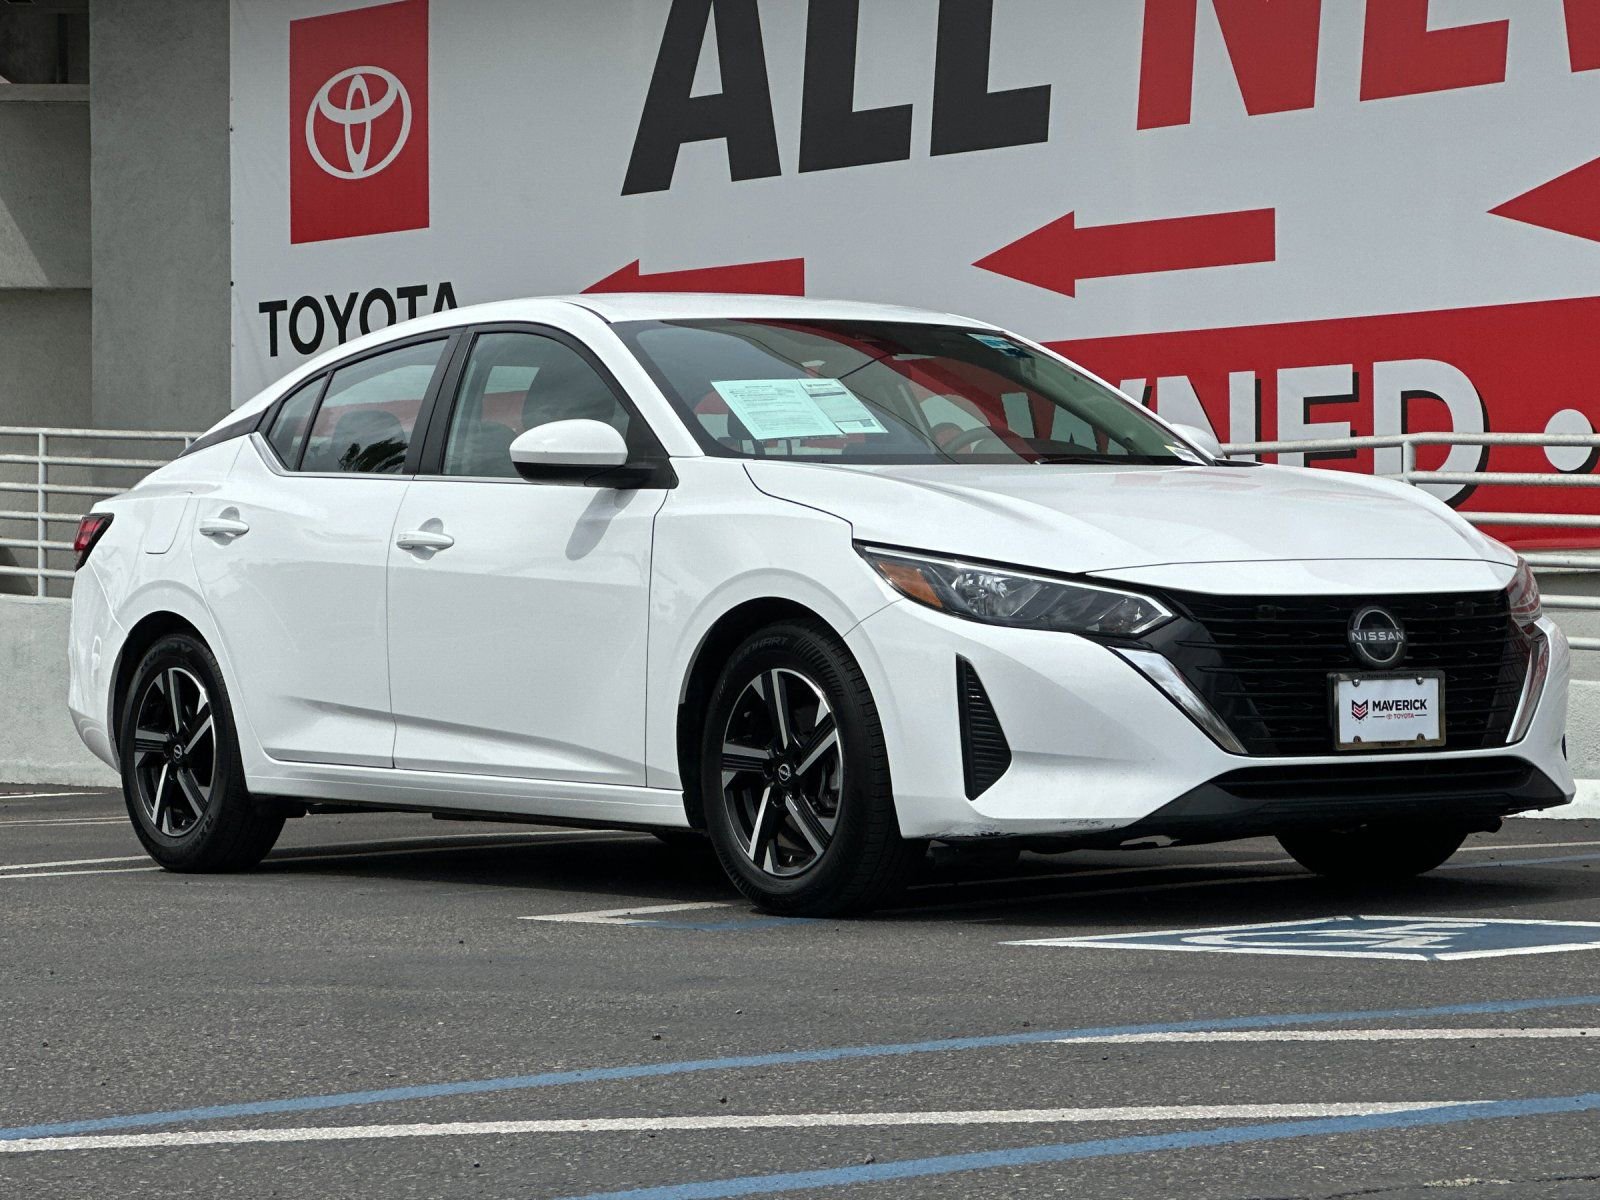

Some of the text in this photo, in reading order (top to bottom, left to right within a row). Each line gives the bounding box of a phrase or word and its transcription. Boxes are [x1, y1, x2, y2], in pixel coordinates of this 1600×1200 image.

[620, 0, 1052, 196] ALL
[1352, 631, 1404, 641] NISSAN
[1373, 699, 1427, 711] MAVERICK
